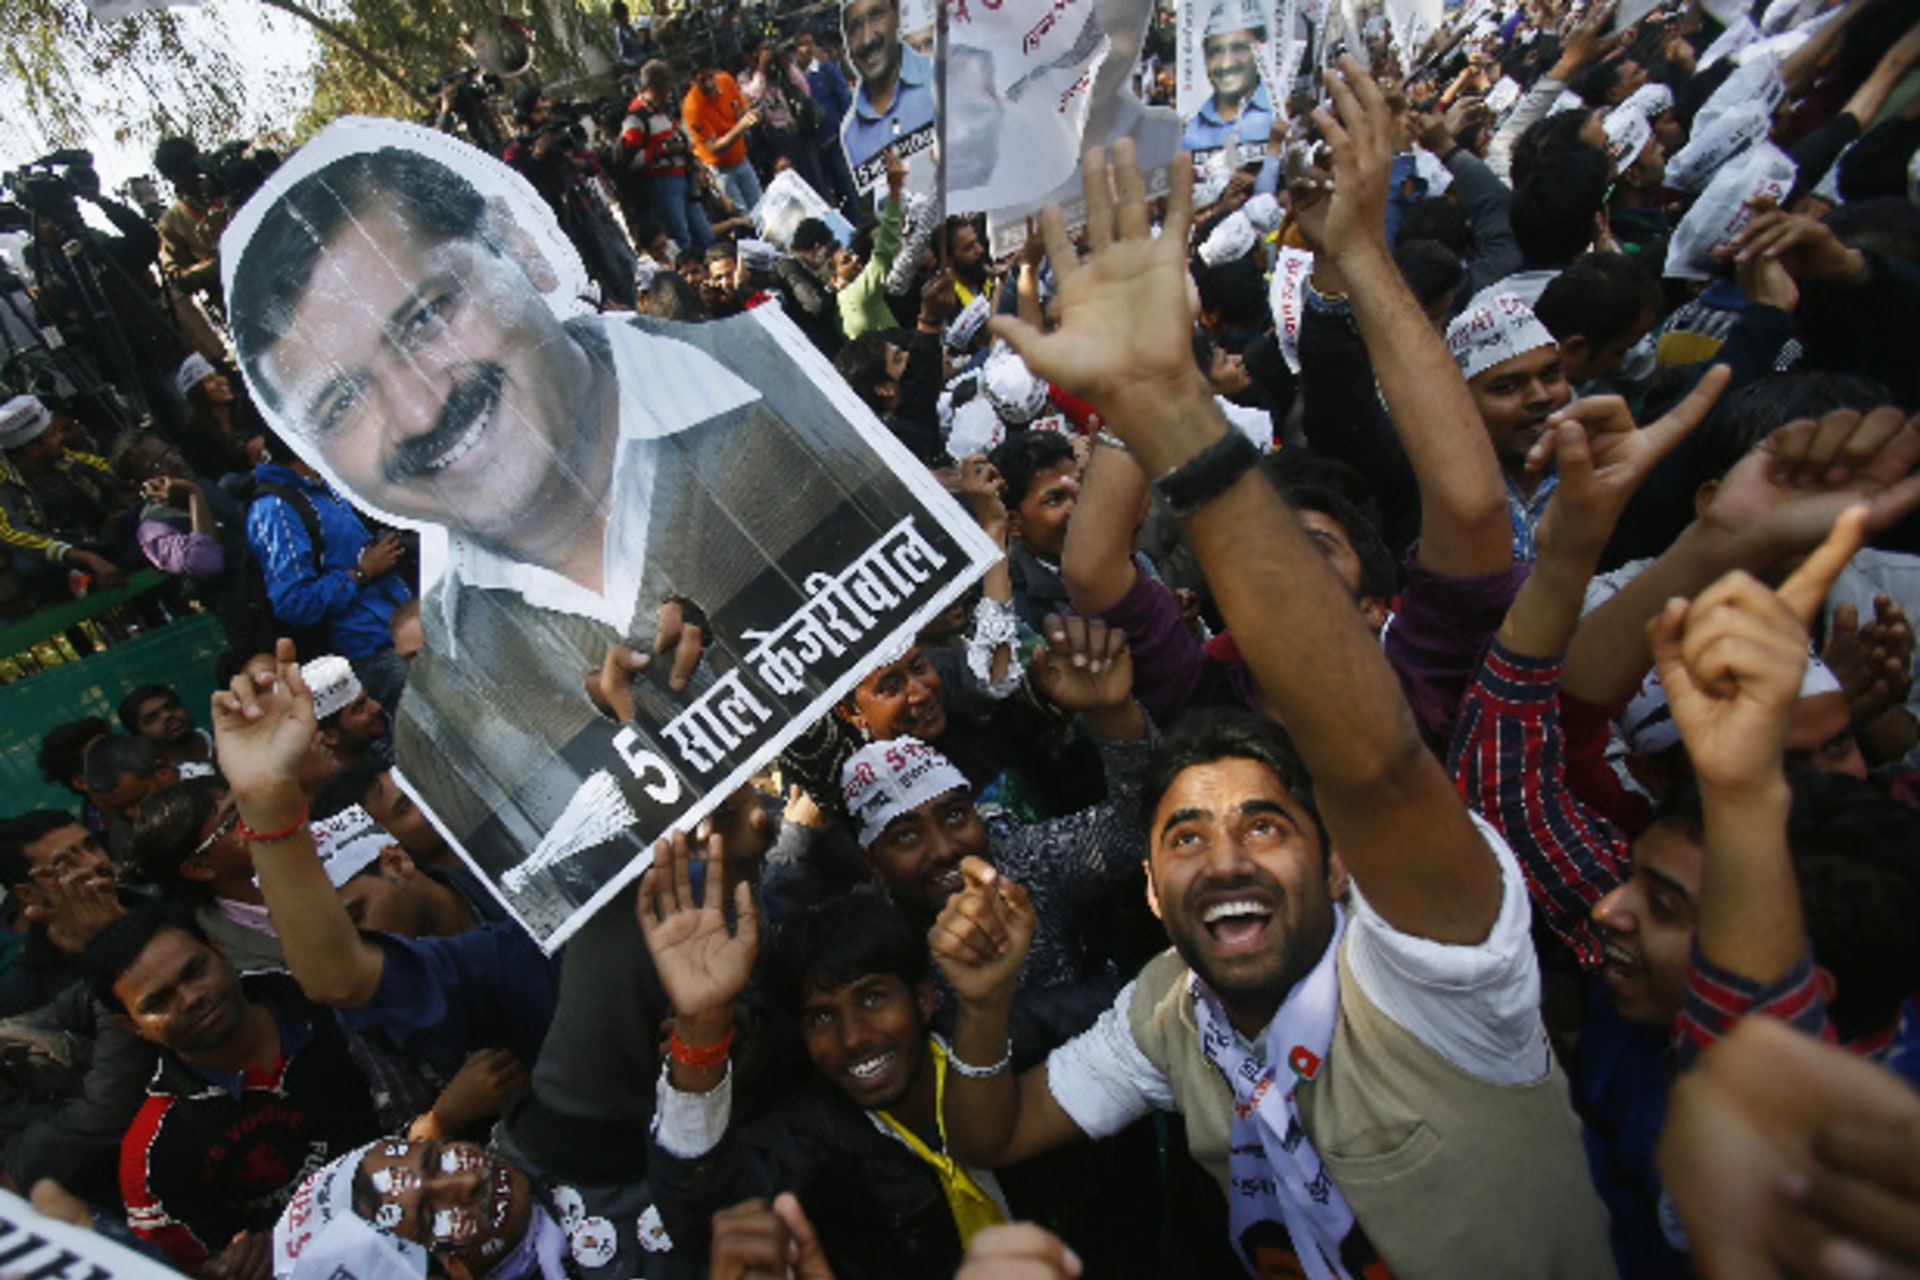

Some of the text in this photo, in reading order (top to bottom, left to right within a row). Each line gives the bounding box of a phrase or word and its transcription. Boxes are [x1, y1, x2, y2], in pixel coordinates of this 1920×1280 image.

[612, 727, 682, 804] 5
[660, 667, 773, 773] साल
[740, 514, 947, 696] केजरीवाल
